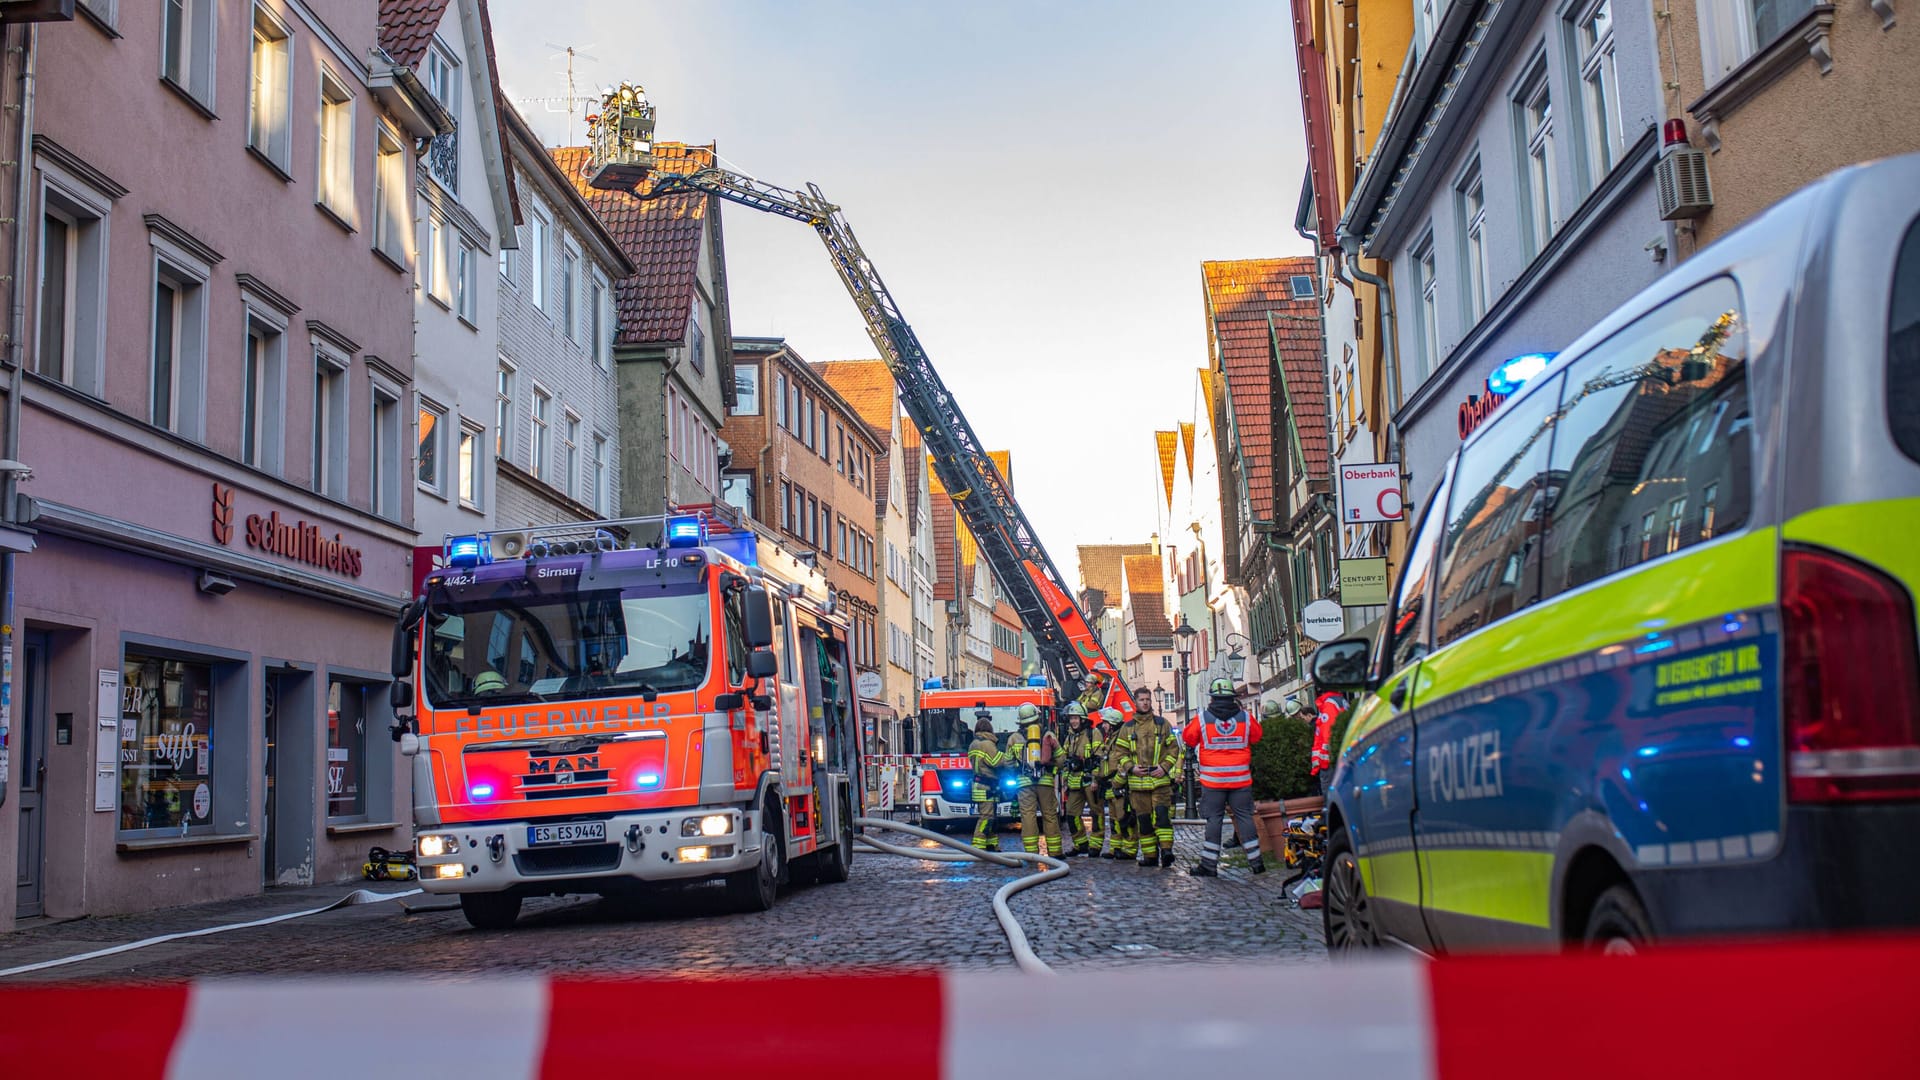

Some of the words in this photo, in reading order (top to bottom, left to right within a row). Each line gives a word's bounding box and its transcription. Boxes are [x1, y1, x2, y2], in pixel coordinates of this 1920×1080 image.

[1344, 468, 1396, 480] Oberbank
[245, 510, 362, 577] schultheiss
[646, 559, 662, 569] LF
[664, 558, 678, 568] 10
[538, 567, 577, 578] Sirnau
[444, 575, 477, 587] 4/42-1
[1342, 575, 1376, 583] CENTURY
[1306, 616, 1342, 624] burkhardt
[455, 703, 673, 741] FEUERWEHR
[156, 722, 196, 771] süß
[528, 755, 600, 774] MAN
[940, 759, 973, 769] FEU
[1429, 729, 1504, 803] POLIZEI
[535, 828, 550, 841] ES
[558, 826, 572, 840] ES
[575, 824, 603, 839] 9442
